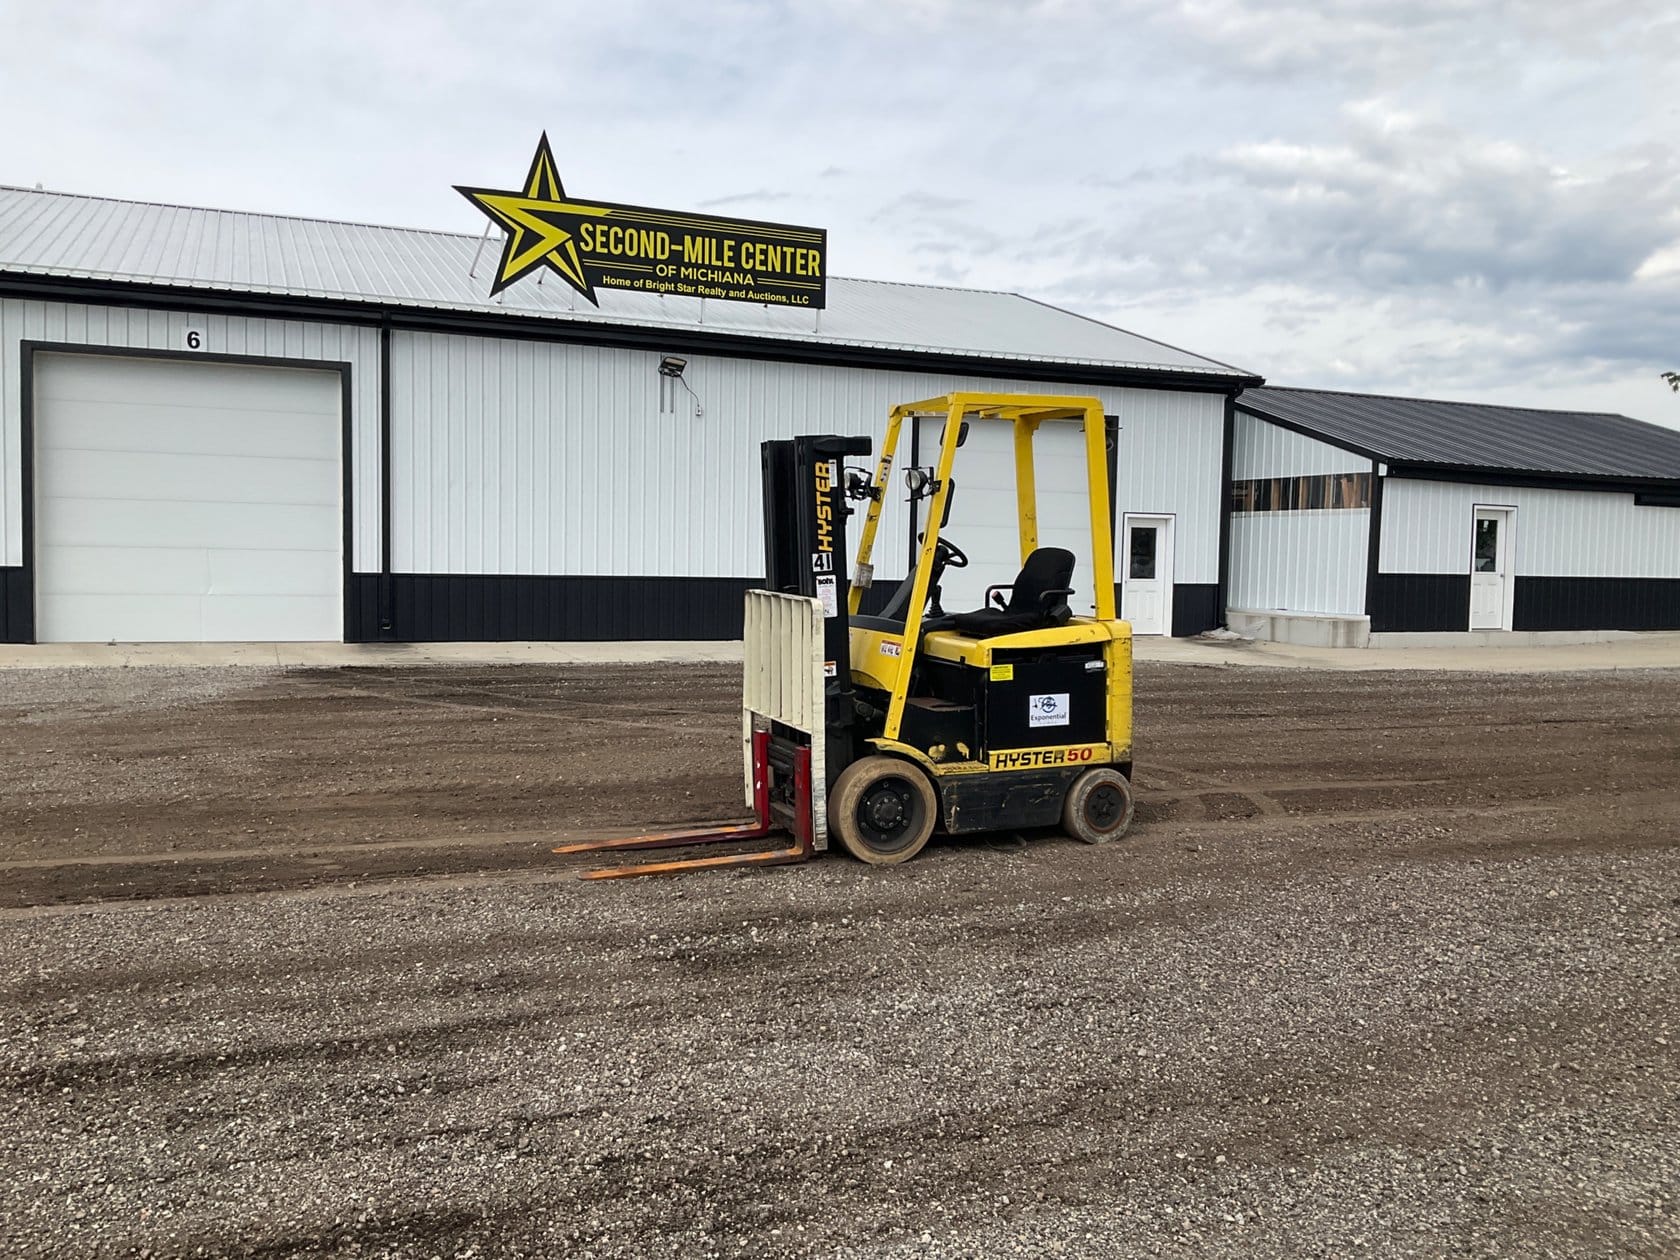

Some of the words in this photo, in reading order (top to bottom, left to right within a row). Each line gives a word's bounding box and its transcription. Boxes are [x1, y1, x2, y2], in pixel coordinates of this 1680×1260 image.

[579, 222, 736, 268] SECOND-MILE
[741, 241, 821, 277] CENTER
[656, 264, 677, 277] OF
[680, 266, 755, 286] MICHIANA
[602, 275, 632, 287] Home
[633, 278, 644, 289] of
[645, 279, 675, 292] Bright
[677, 283, 696, 293] Star
[697, 285, 726, 298] Realty
[728, 289, 746, 299] and
[747, 290, 790, 304] Auctions,
[791, 294, 810, 304] LLC
[187, 331, 201, 349] 6
[815, 461, 834, 552] HYSTER
[814, 553, 832, 571] 41
[1030, 711, 1067, 722] Exponential
[995, 750, 1065, 769] HYSTER
[1067, 747, 1093, 762] 50
